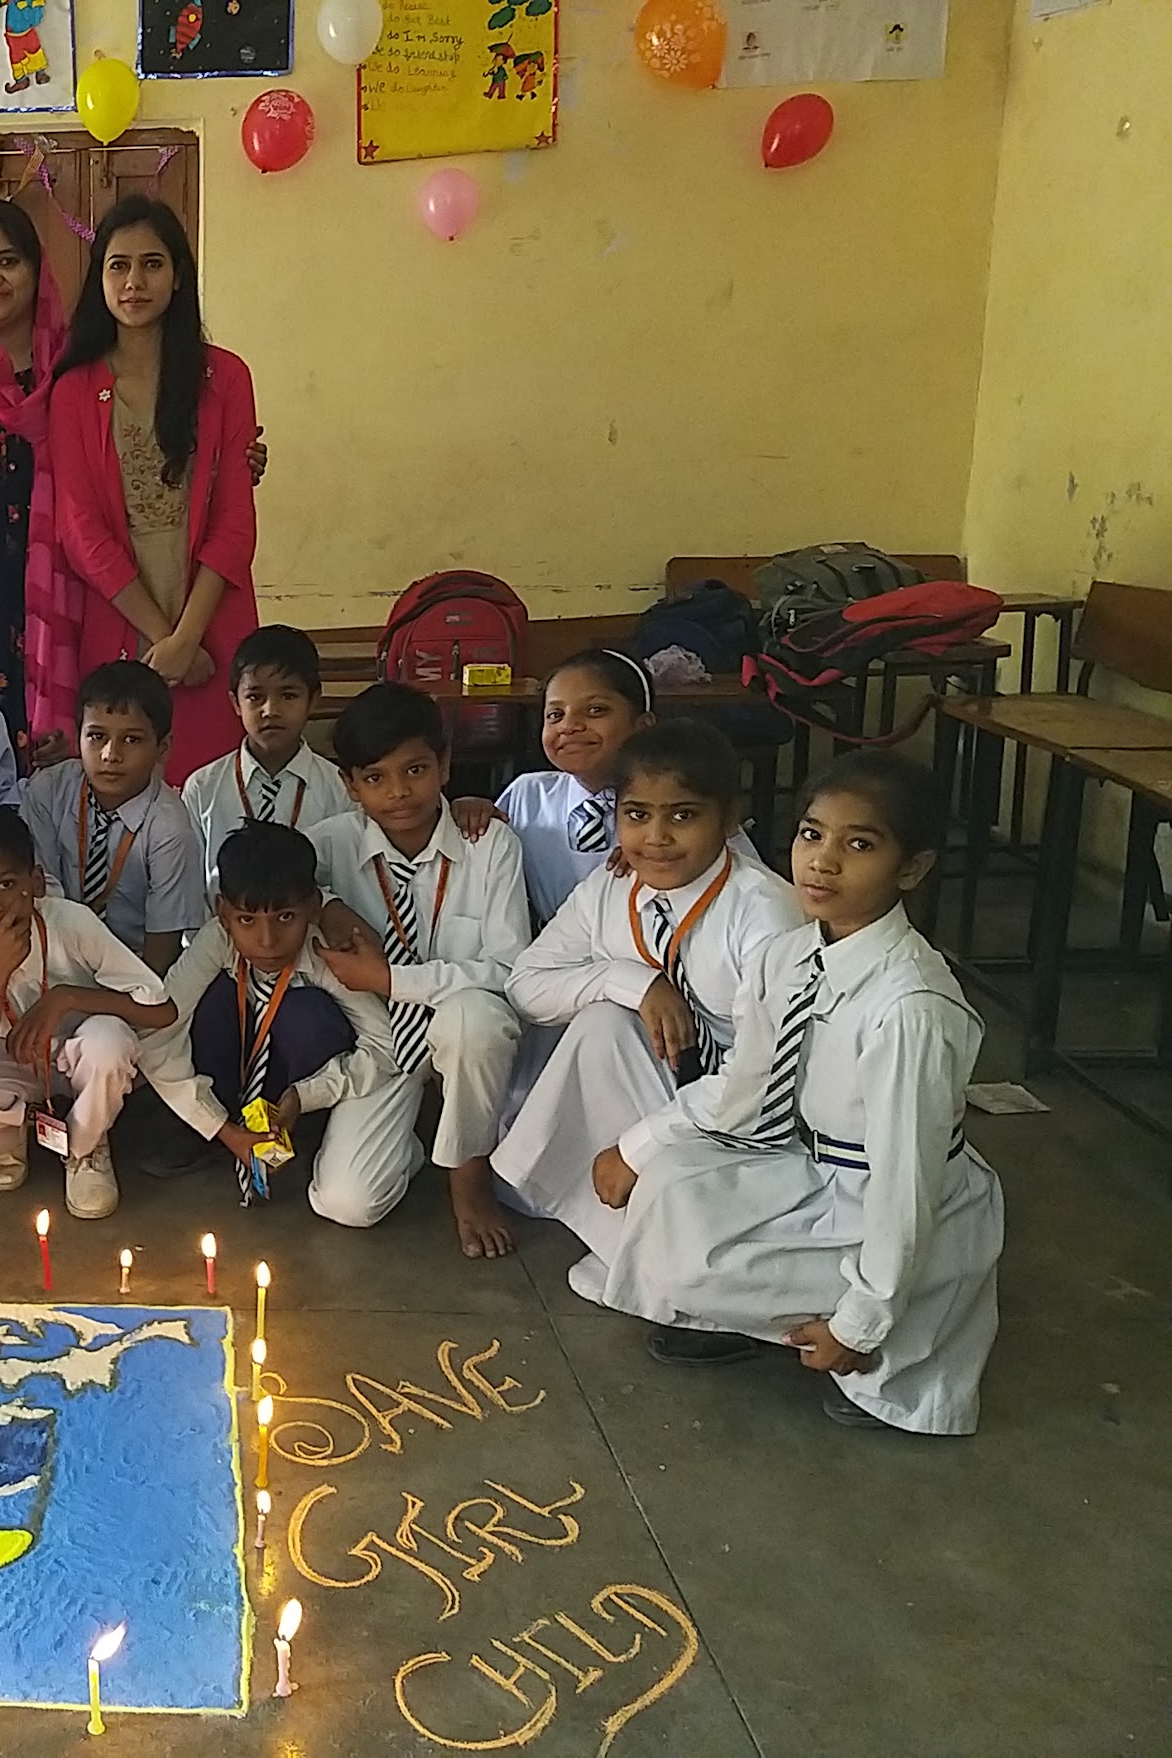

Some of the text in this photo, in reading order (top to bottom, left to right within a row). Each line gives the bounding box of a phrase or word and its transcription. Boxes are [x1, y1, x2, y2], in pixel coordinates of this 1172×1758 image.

[259, 1339, 547, 1466] SAVE
[288, 1479, 586, 1621] GIRL
[394, 1583, 699, 1758] CHILD
